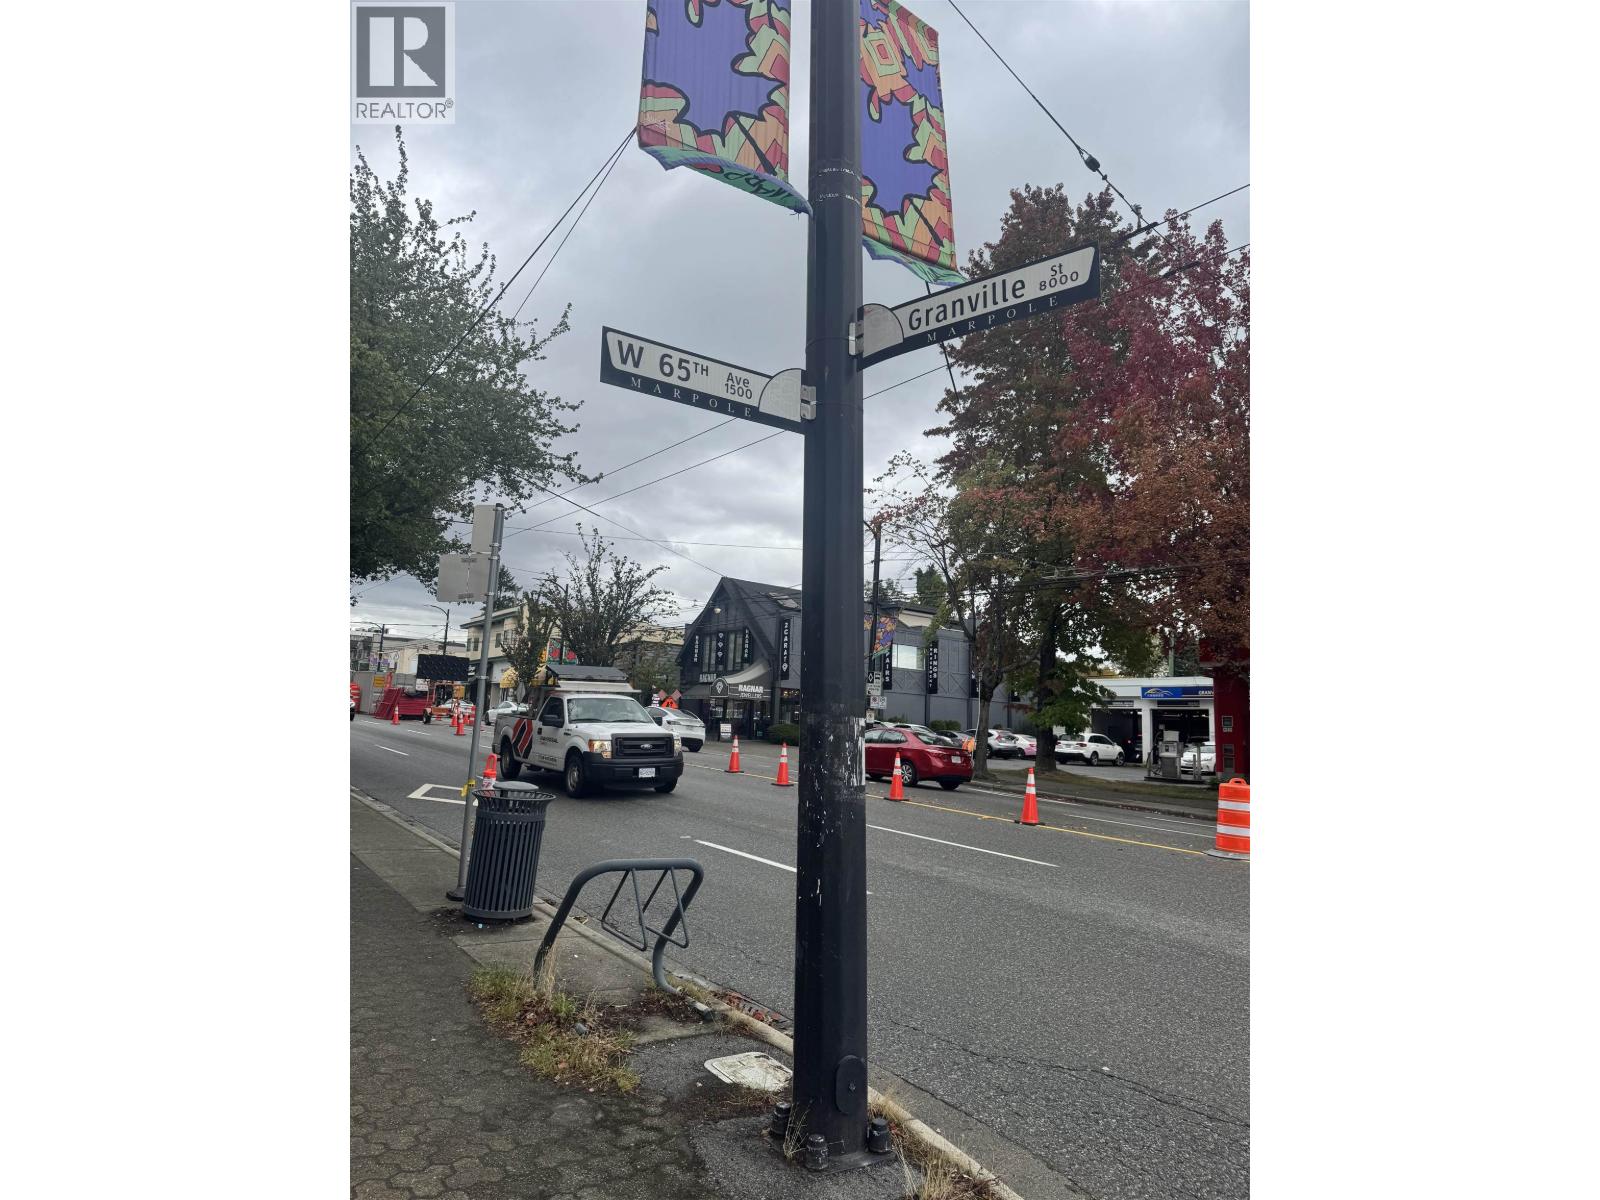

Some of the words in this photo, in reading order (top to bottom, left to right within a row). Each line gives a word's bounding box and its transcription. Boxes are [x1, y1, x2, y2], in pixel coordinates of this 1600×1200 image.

[908, 278, 1026, 331] Granville
[1050, 262, 1064, 277] St
[1039, 271, 1080, 291] 8000
[927, 296, 1058, 343] MARPOLE
[612, 339, 645, 369] W
[659, 353, 709, 382] 65TH
[726, 372, 750, 388] Ave
[631, 376, 752, 417] MARPOLE
[724, 383, 753, 400] 1500
[738, 684, 764, 693] RAGNAR
